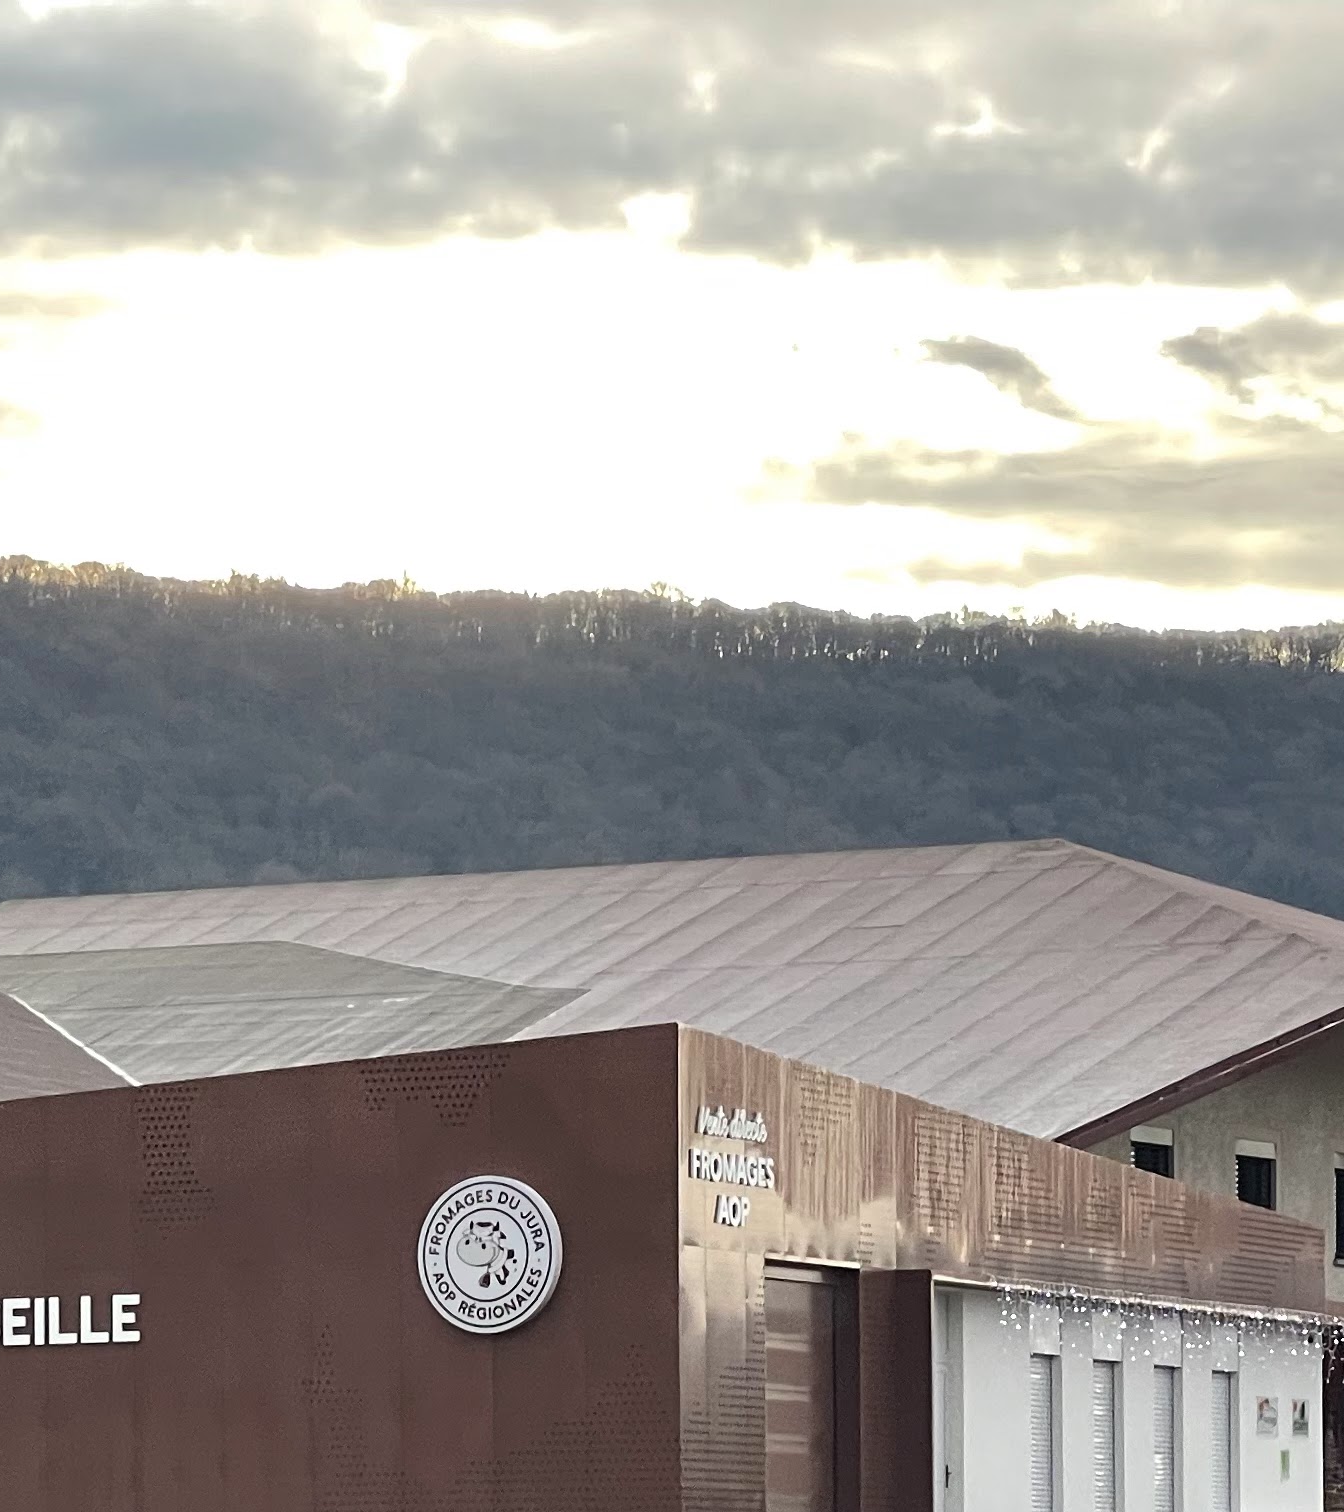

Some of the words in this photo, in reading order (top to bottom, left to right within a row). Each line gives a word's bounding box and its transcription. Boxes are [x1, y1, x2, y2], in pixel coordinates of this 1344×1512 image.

[691, 1148, 775, 1189] FROMAGES
[429, 1189, 493, 1256] FROMAGES
[497, 1191, 520, 1210] DU
[520, 1209, 546, 1252] JURA
[717, 1194, 751, 1227] AOP
[432, 1271, 457, 1301] AOP
[458, 1268, 543, 1320] RÉGIONALES
